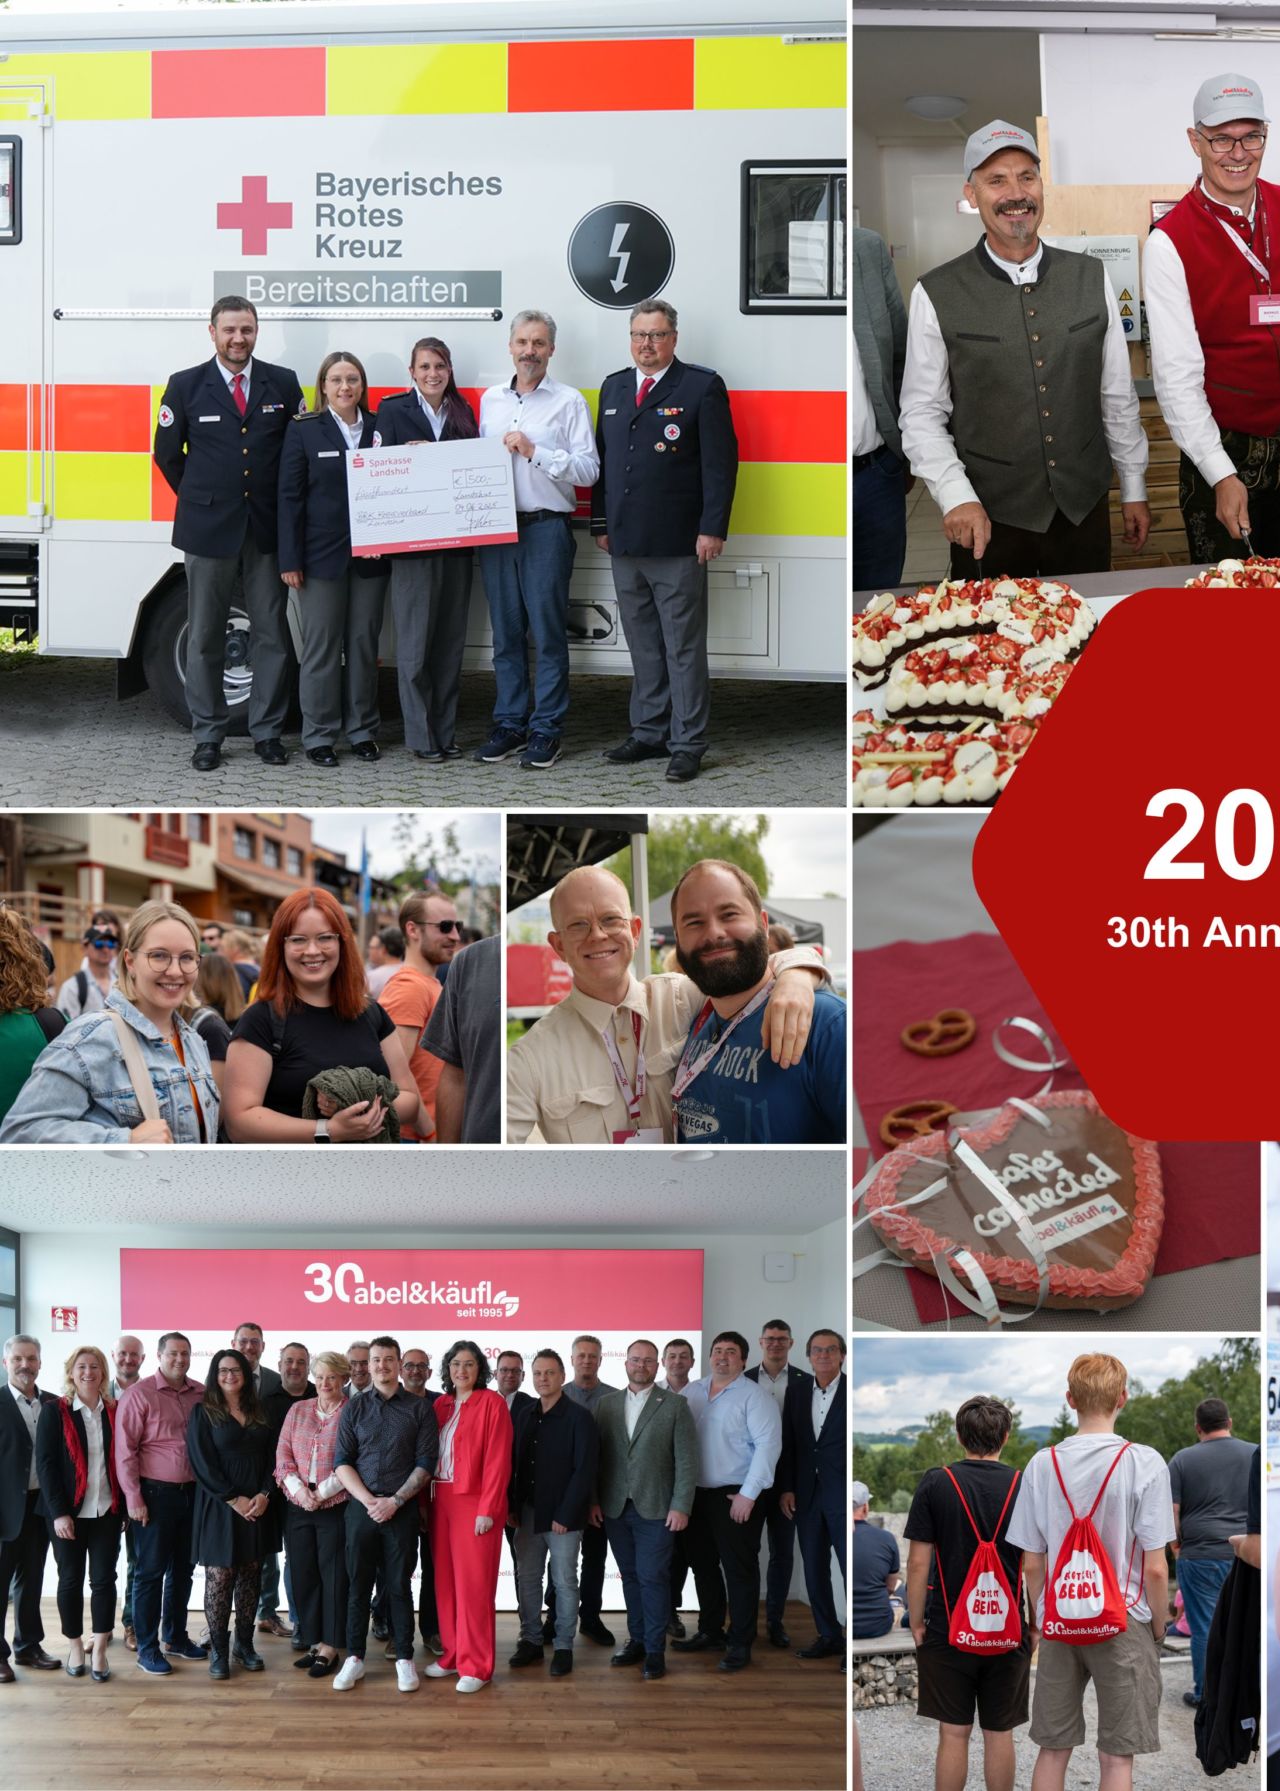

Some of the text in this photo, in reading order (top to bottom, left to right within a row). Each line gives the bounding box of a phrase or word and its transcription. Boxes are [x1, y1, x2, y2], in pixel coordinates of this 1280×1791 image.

[316, 172, 502, 201] Bayerisches
[316, 203, 403, 228] Rotes
[316, 234, 402, 258] Kreuz
[246, 274, 468, 303] Bereitschaften
[369, 456, 412, 468] Sparkasse
[370, 467, 410, 478] Landshut
[713, 1045, 766, 1084] ROCK
[686, 1116, 713, 1132] VEGAS
[973, 1153, 1122, 1236] conected
[304, 1262, 492, 1304] 30 abel&käufl
[456, 1307, 503, 1318] seit 1995
[1058, 1582, 1102, 1600] BEIDL
[972, 1598, 1004, 1615] BEIDL
